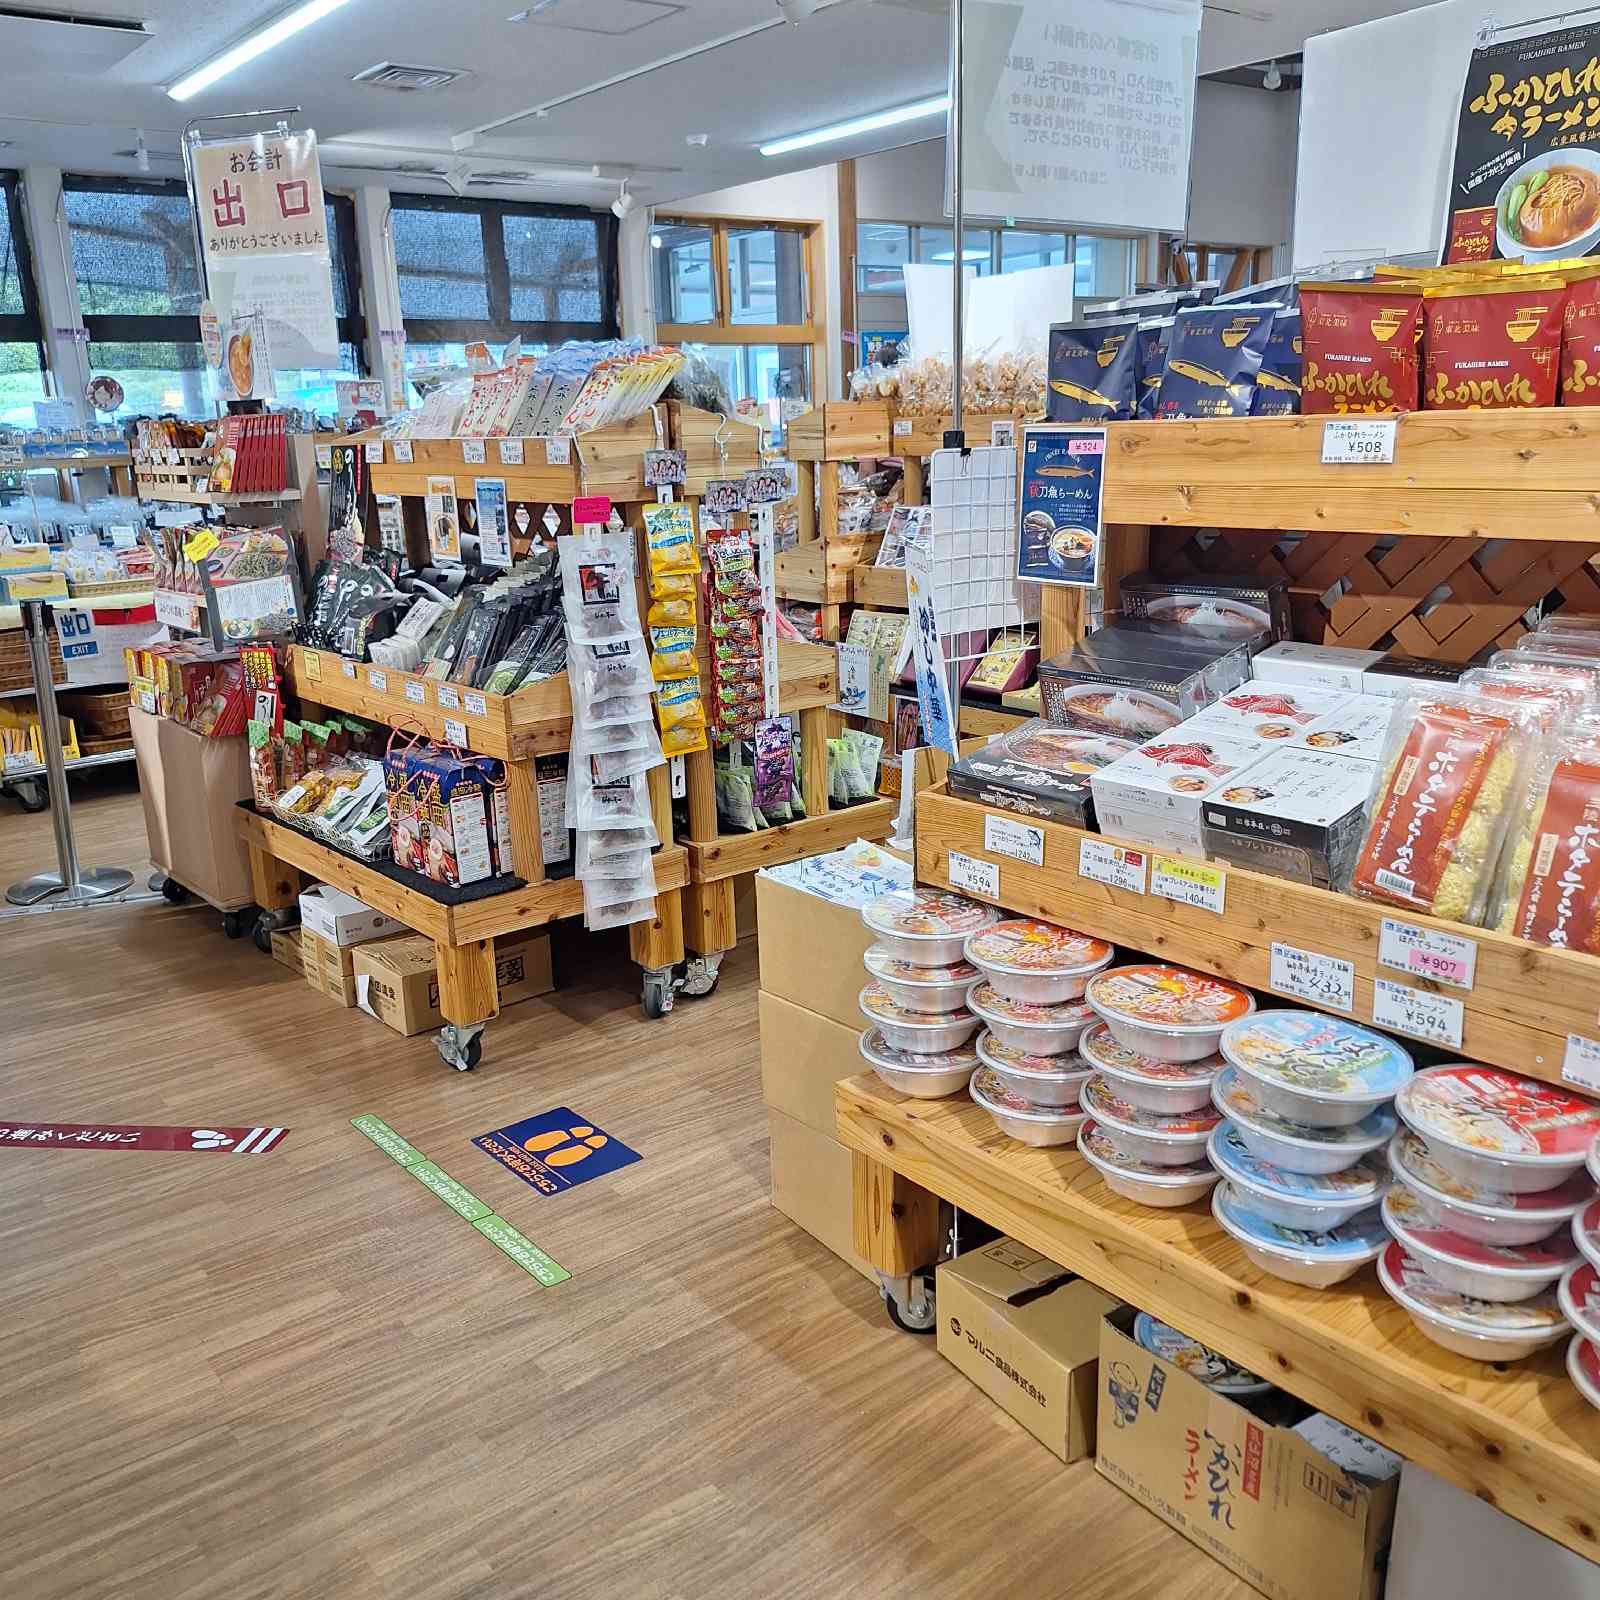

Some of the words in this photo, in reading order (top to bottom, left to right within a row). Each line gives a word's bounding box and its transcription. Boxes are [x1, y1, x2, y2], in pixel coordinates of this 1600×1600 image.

[1557, 41, 1586, 55] RAMEN
[230, 148, 282, 173] お会計
[209, 229, 325, 252] ありがとうございました
[1427, 372, 1537, 404] ふかひれ
[1075, 443, 1098, 451] ¥324
[1348, 441, 1383, 453] ¥508
[1029, 485, 1093, 500] 秋刀魚らーめん
[60, 613, 91, 638] 出口
[71, 644, 89, 656] EXIT
[967, 873, 991, 888] ¥594
[1399, 936, 1457, 956] ほたてラーメン
[1420, 954, 1457, 973] ¥907
[1391, 993, 1447, 1015] ほたてラーメン
[1405, 1008, 1447, 1032] ¥594
[479, 1136, 558, 1194] こちらでお待ちください
[480, 1219, 555, 1282] こちらでお待ちください
